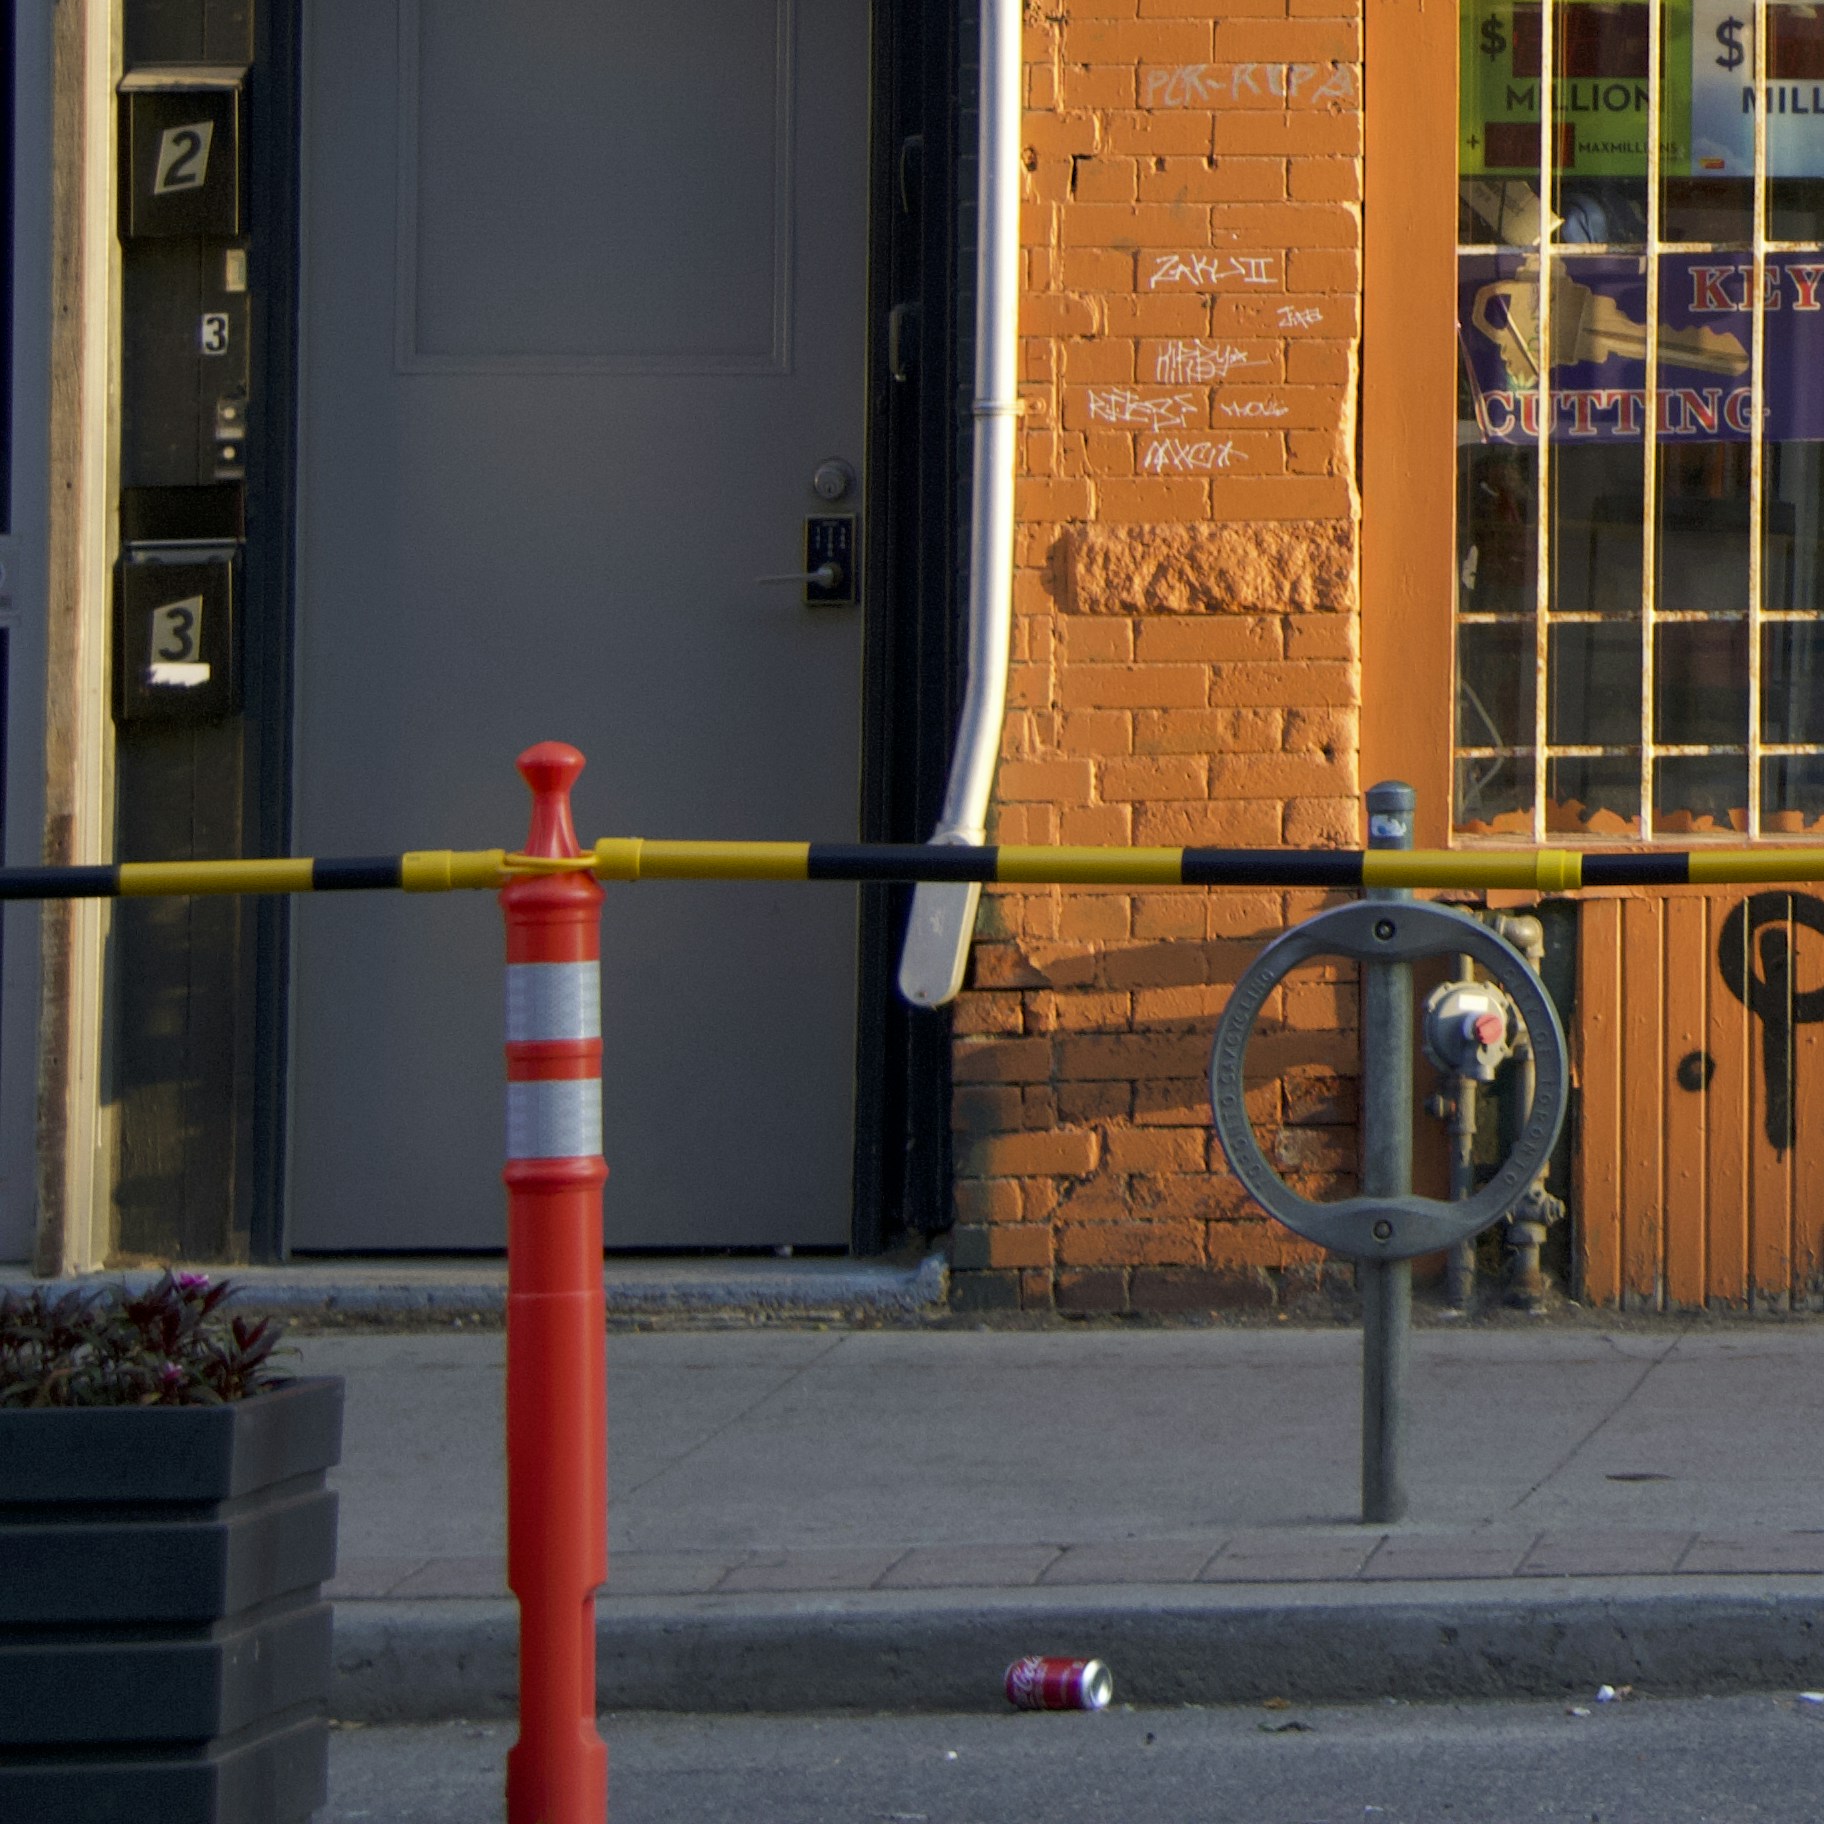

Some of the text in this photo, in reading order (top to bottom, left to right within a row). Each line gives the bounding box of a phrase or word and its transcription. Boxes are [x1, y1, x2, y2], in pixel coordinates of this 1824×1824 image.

[163, 131, 201, 186] 2
[204, 317, 227, 353] 3
[1483, 388, 1771, 436] CUTTING
[157, 607, 195, 664] 3
